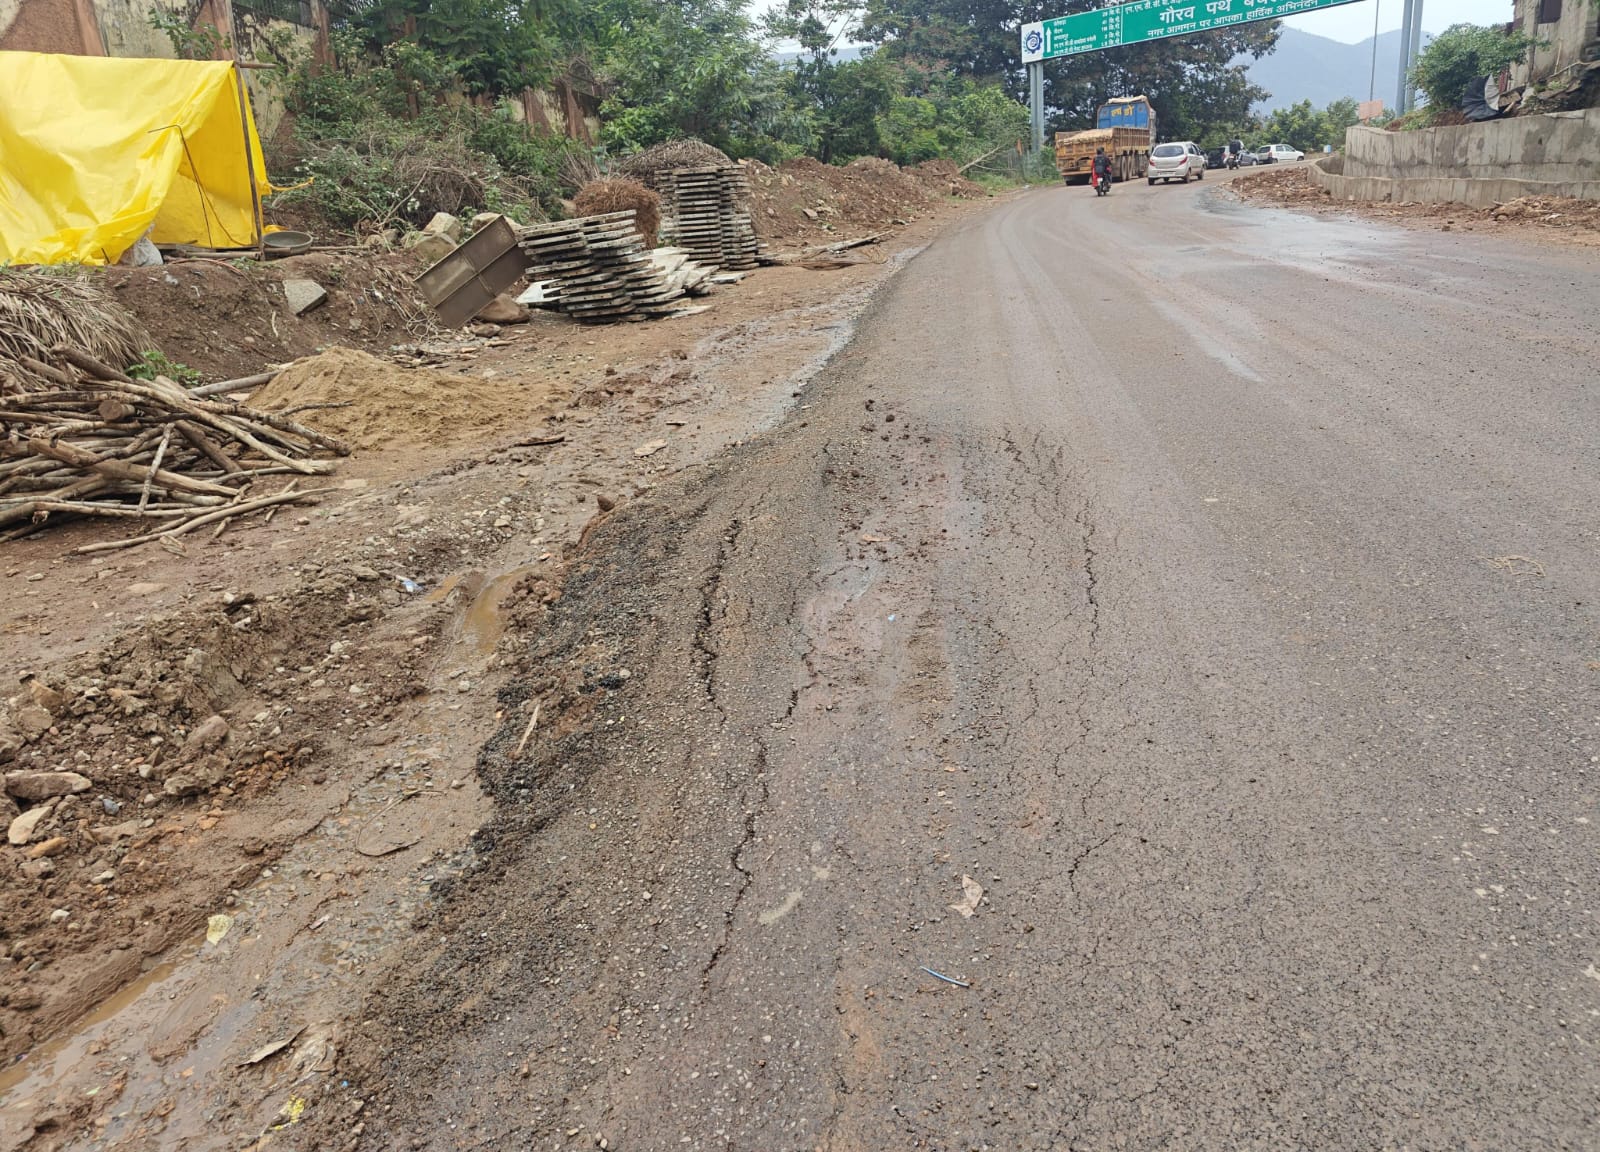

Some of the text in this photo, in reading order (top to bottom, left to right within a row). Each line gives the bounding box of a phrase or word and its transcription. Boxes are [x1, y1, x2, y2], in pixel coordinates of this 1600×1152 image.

[1147, 28, 1165, 37] नगर
[1199, 19, 1211, 28] पर
[1214, 13, 1243, 25] आपका
[1246, 6, 1273, 20] हार्दिक
[1160, 6, 1196, 24] गौरव
[1206, 0, 1233, 14] पथ
